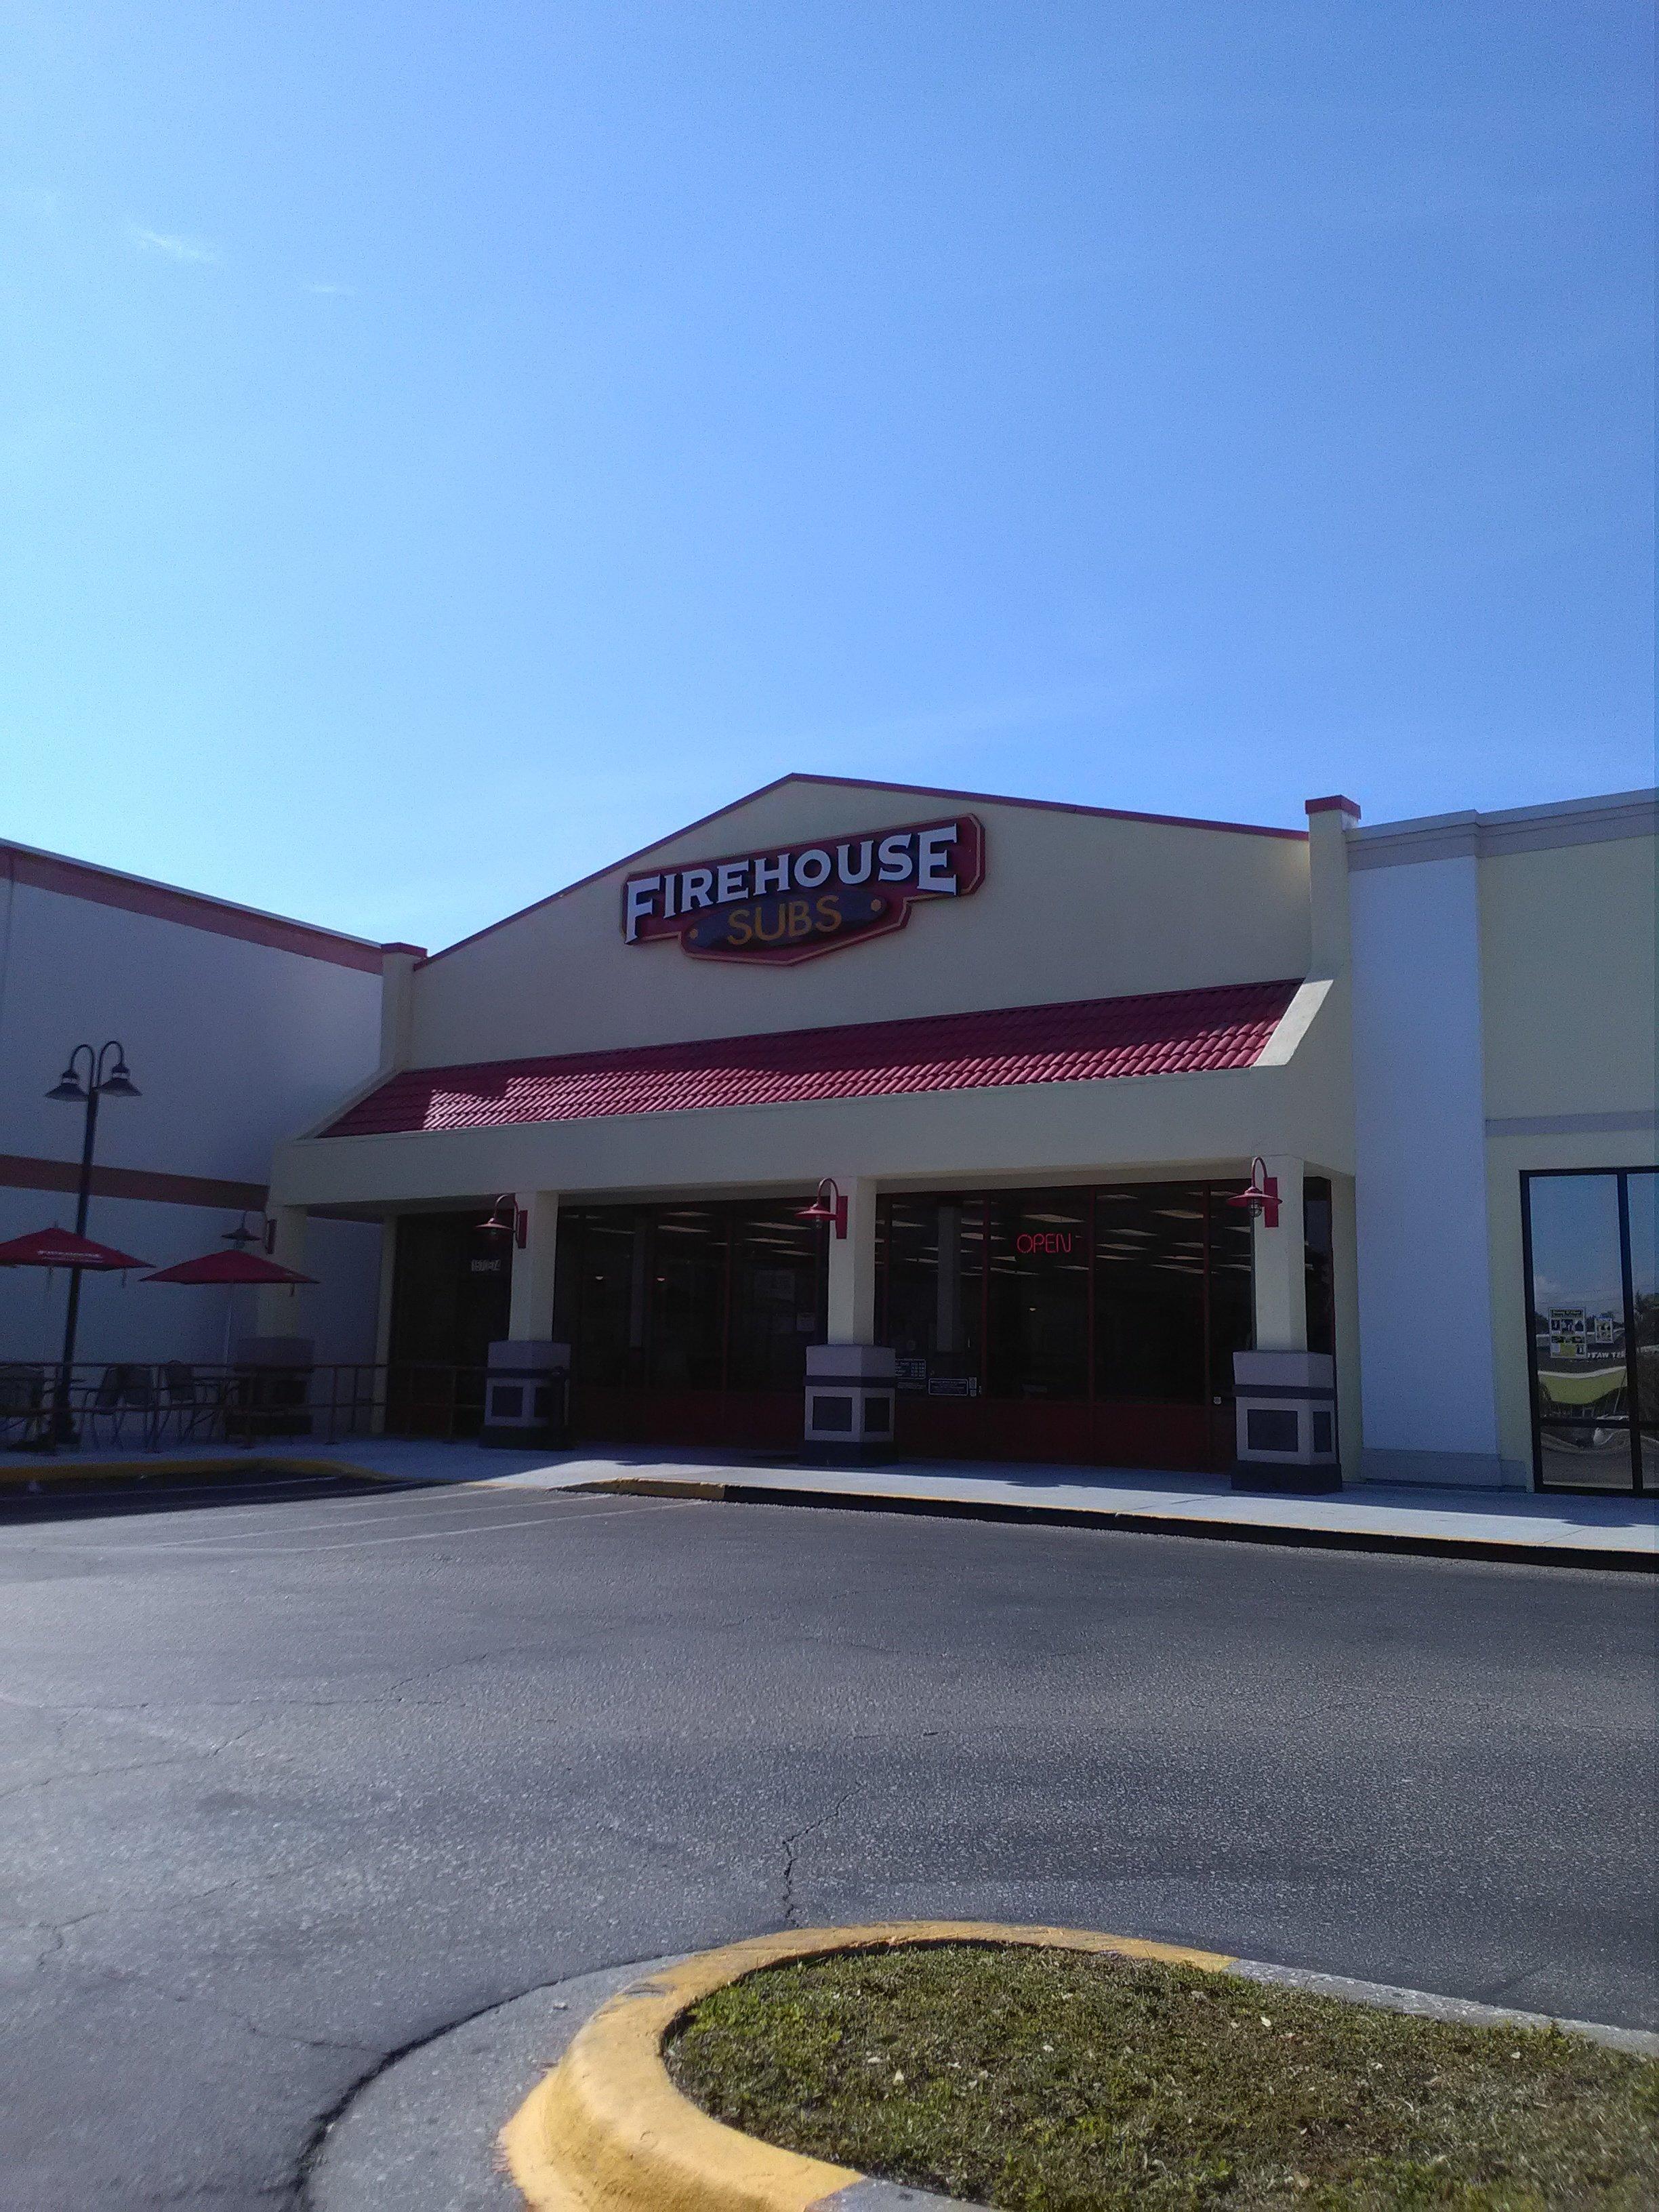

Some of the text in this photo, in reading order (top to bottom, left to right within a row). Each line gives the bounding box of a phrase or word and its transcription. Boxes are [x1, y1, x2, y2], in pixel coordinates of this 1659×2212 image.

[624, 822, 958, 944] FIREHOUSE
[727, 895, 842, 945] SUBS
[1017, 1231, 1072, 1254] OPEN
